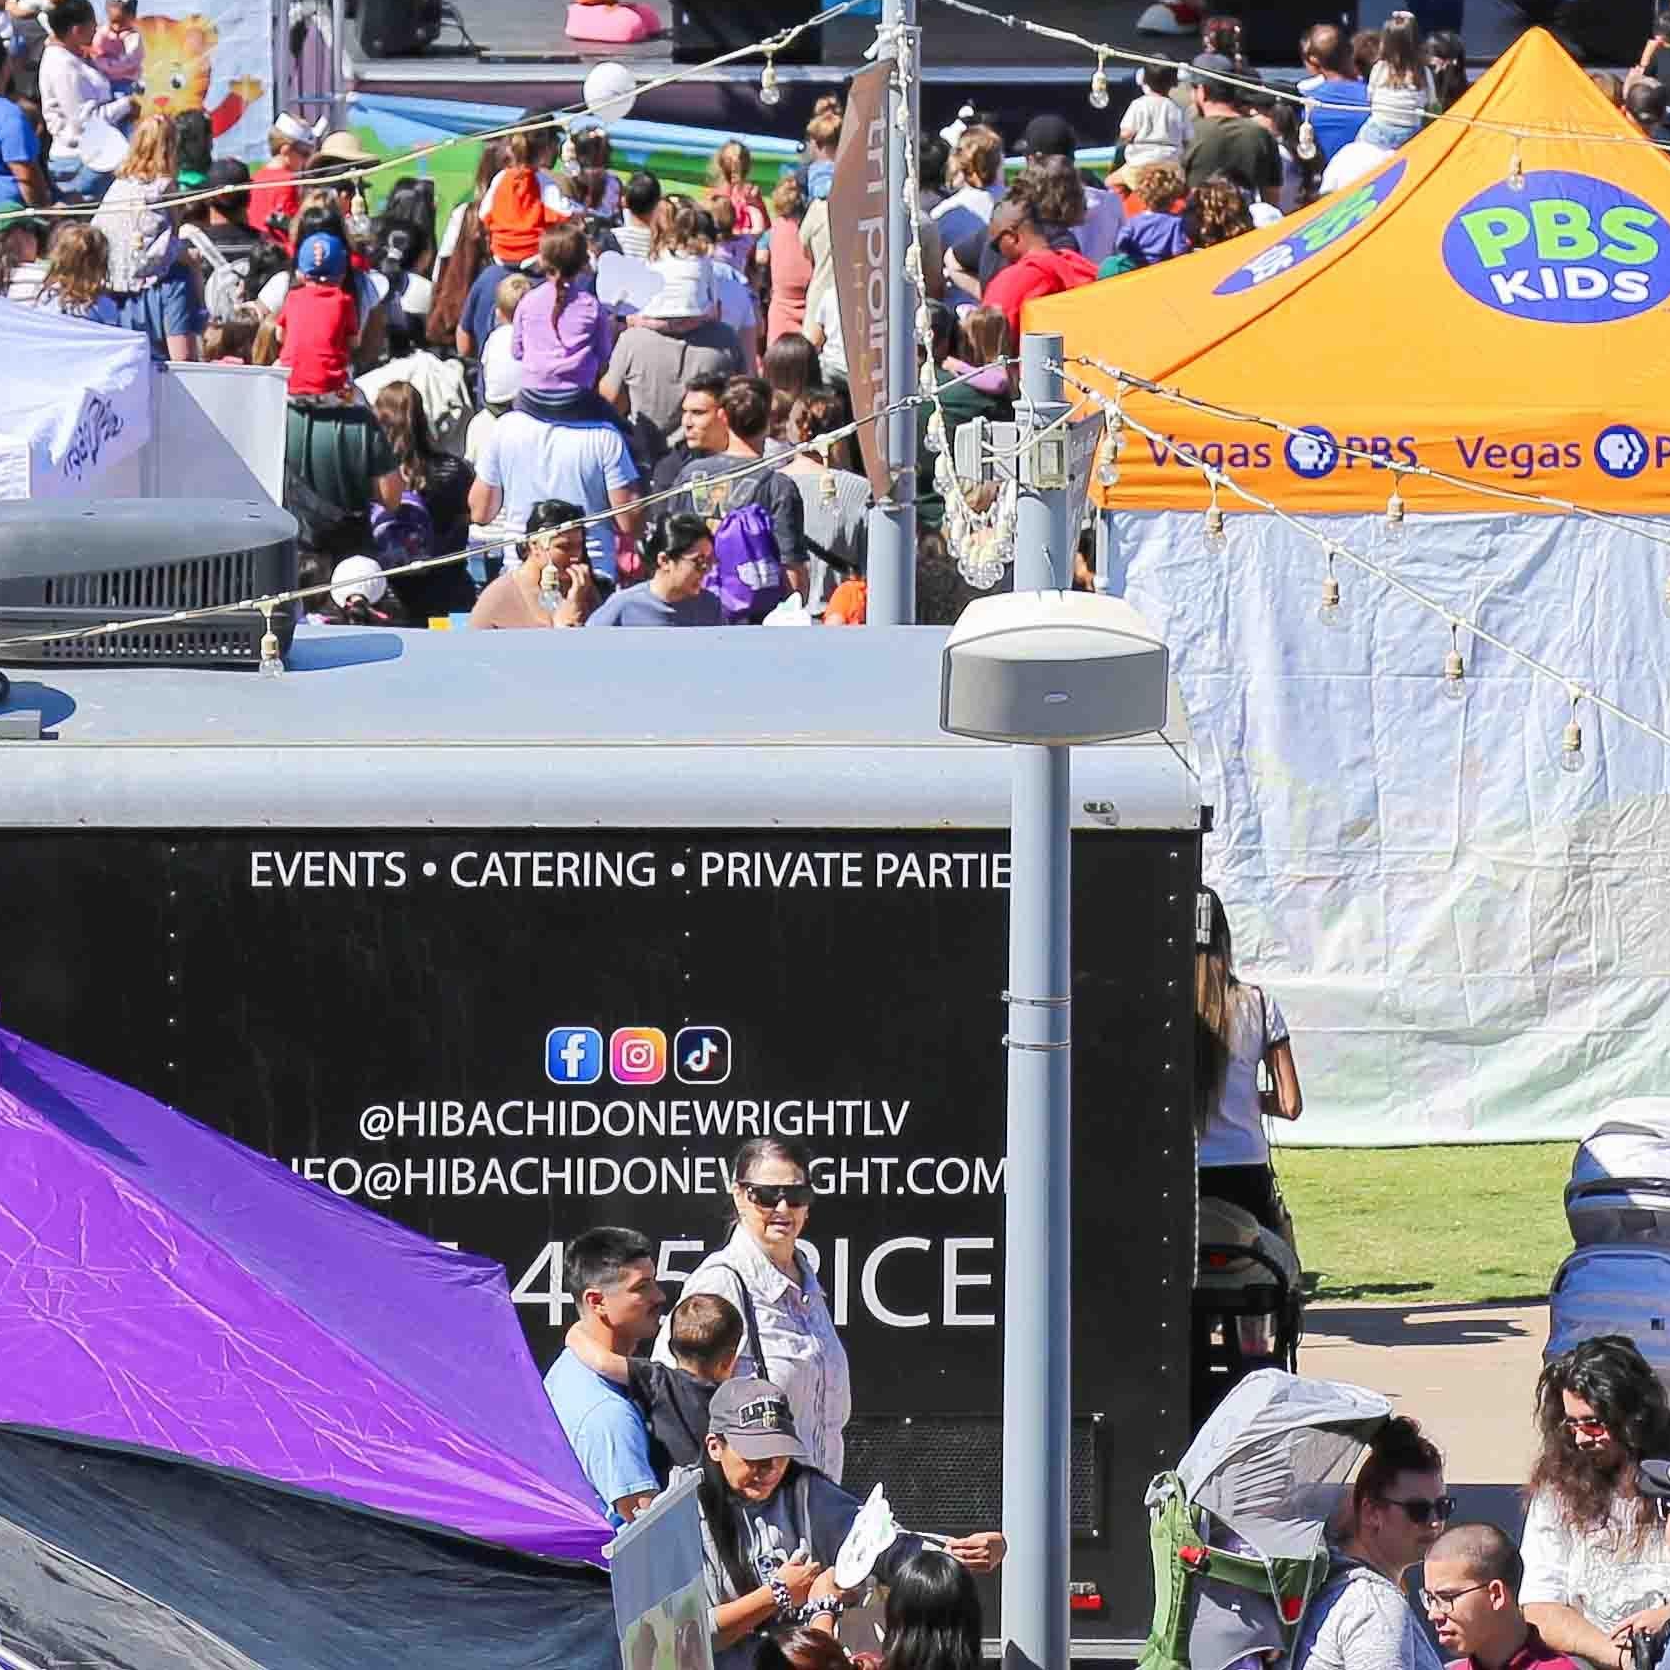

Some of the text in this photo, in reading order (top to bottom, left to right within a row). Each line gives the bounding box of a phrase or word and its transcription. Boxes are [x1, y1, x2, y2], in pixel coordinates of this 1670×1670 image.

[1459, 199, 1660, 269] PBS
[1491, 268, 1651, 307] KIDS
[1146, 434, 1272, 478] Vegas
[1346, 436, 1418, 469] PBS
[1457, 436, 1581, 477] Vegas
[251, 851, 1012, 889] EVENTS CATERING PRIVATE PARTIE
[359, 1100, 911, 1141] @HIBACHIDONEWRIGHTLV
[270, 1156, 1010, 1201] FO@HIBACHIDONEGHT.COM
